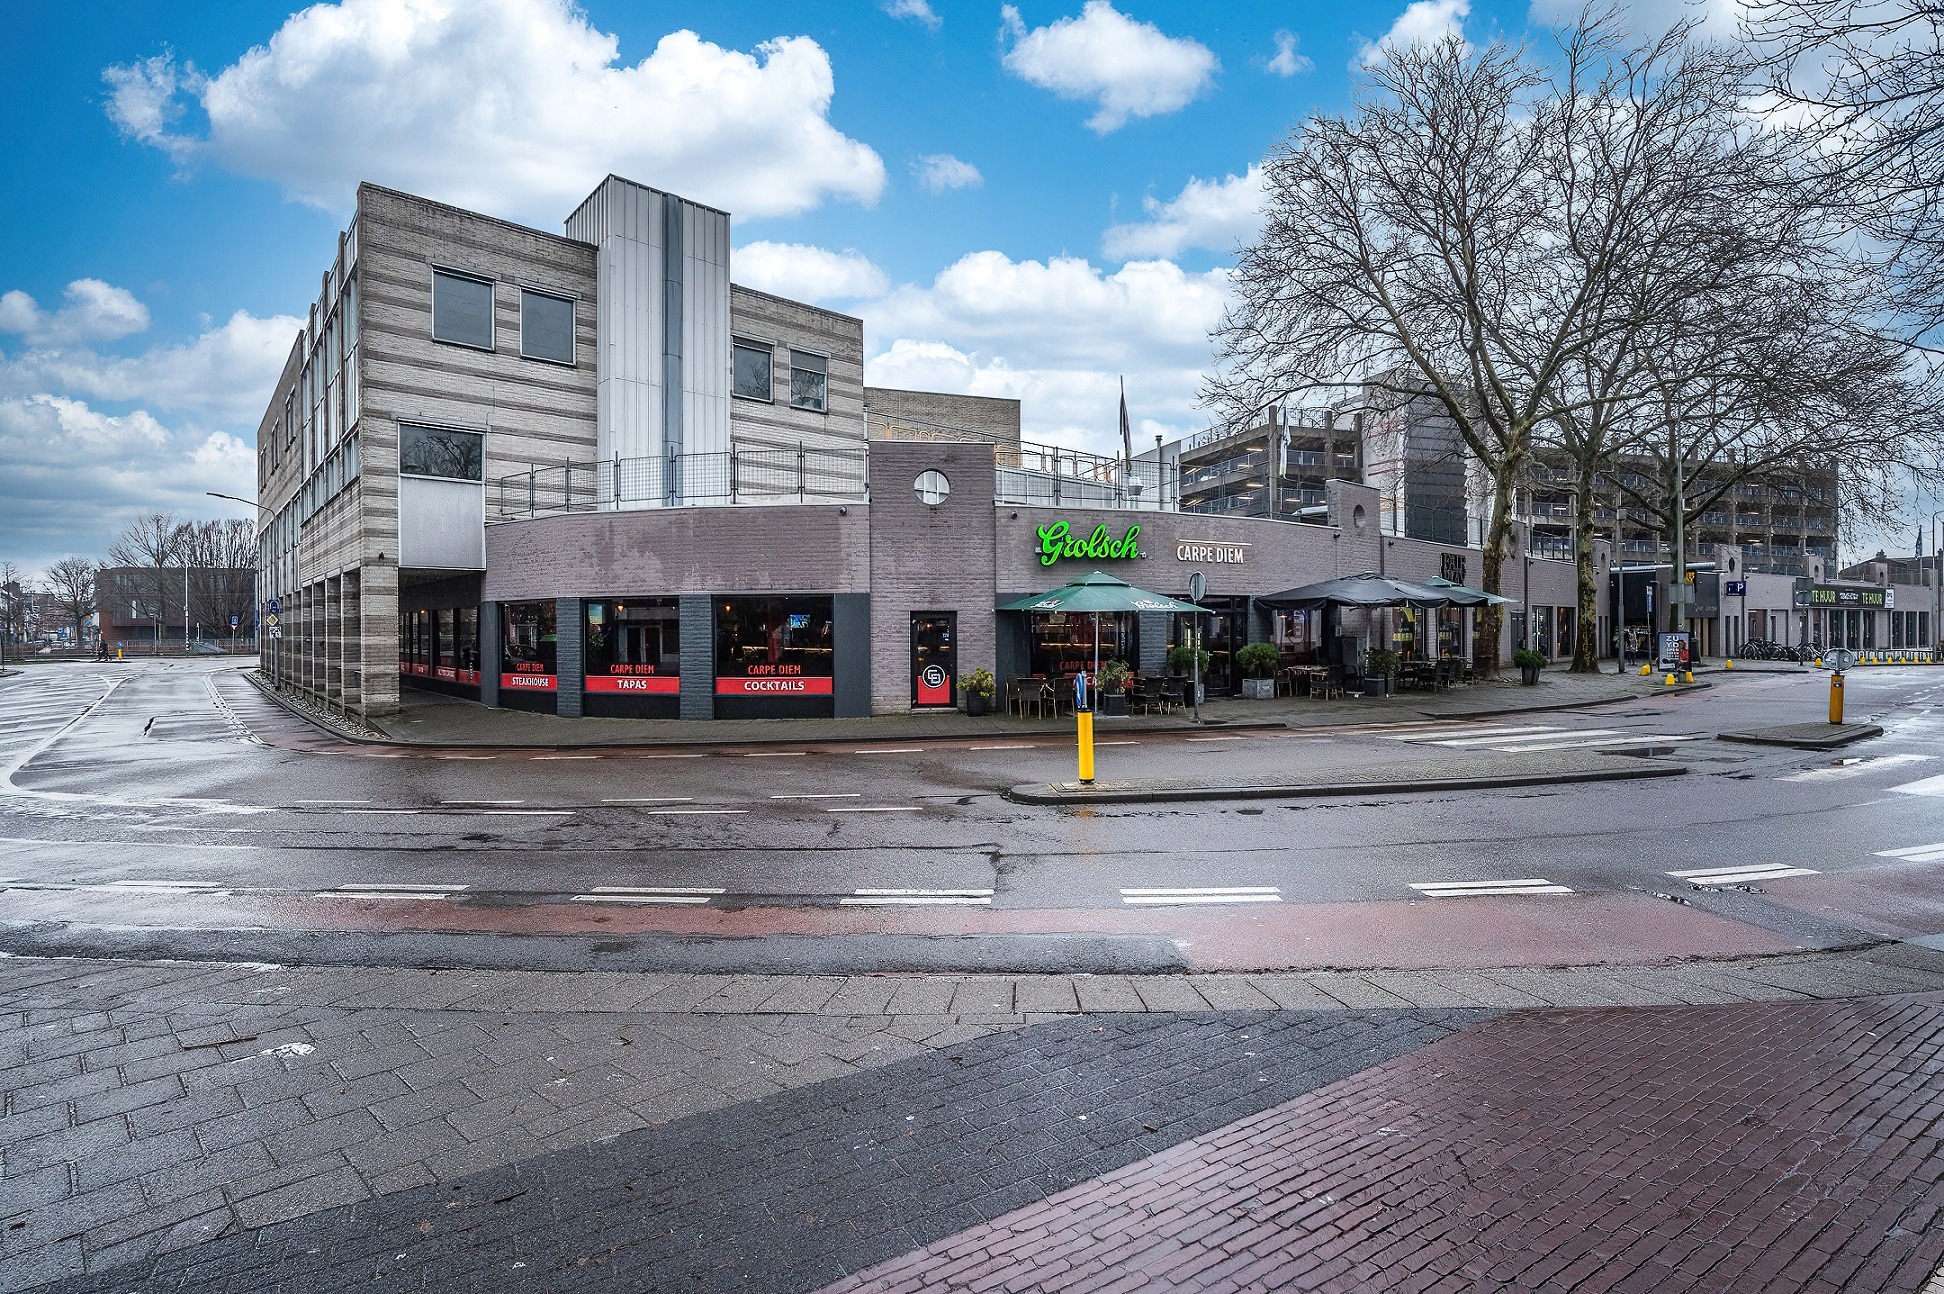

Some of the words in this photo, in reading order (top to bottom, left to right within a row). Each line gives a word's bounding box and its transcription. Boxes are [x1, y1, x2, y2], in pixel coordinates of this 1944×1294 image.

[1037, 521, 1141, 566] Grolsch
[1177, 545, 1213, 562] CARPE
[1216, 548, 1244, 564] DIEM
[610, 664, 633, 674] CARPE
[635, 664, 655, 674] DIEM
[747, 665, 775, 675] CARPE
[778, 665, 801, 675] DIEM
[1060, 661, 1085, 671] CARPE
[512, 677, 549, 687] STEAKHOUSE
[617, 680, 647, 689] TAPAS
[744, 681, 805, 691] COCKTAILS
